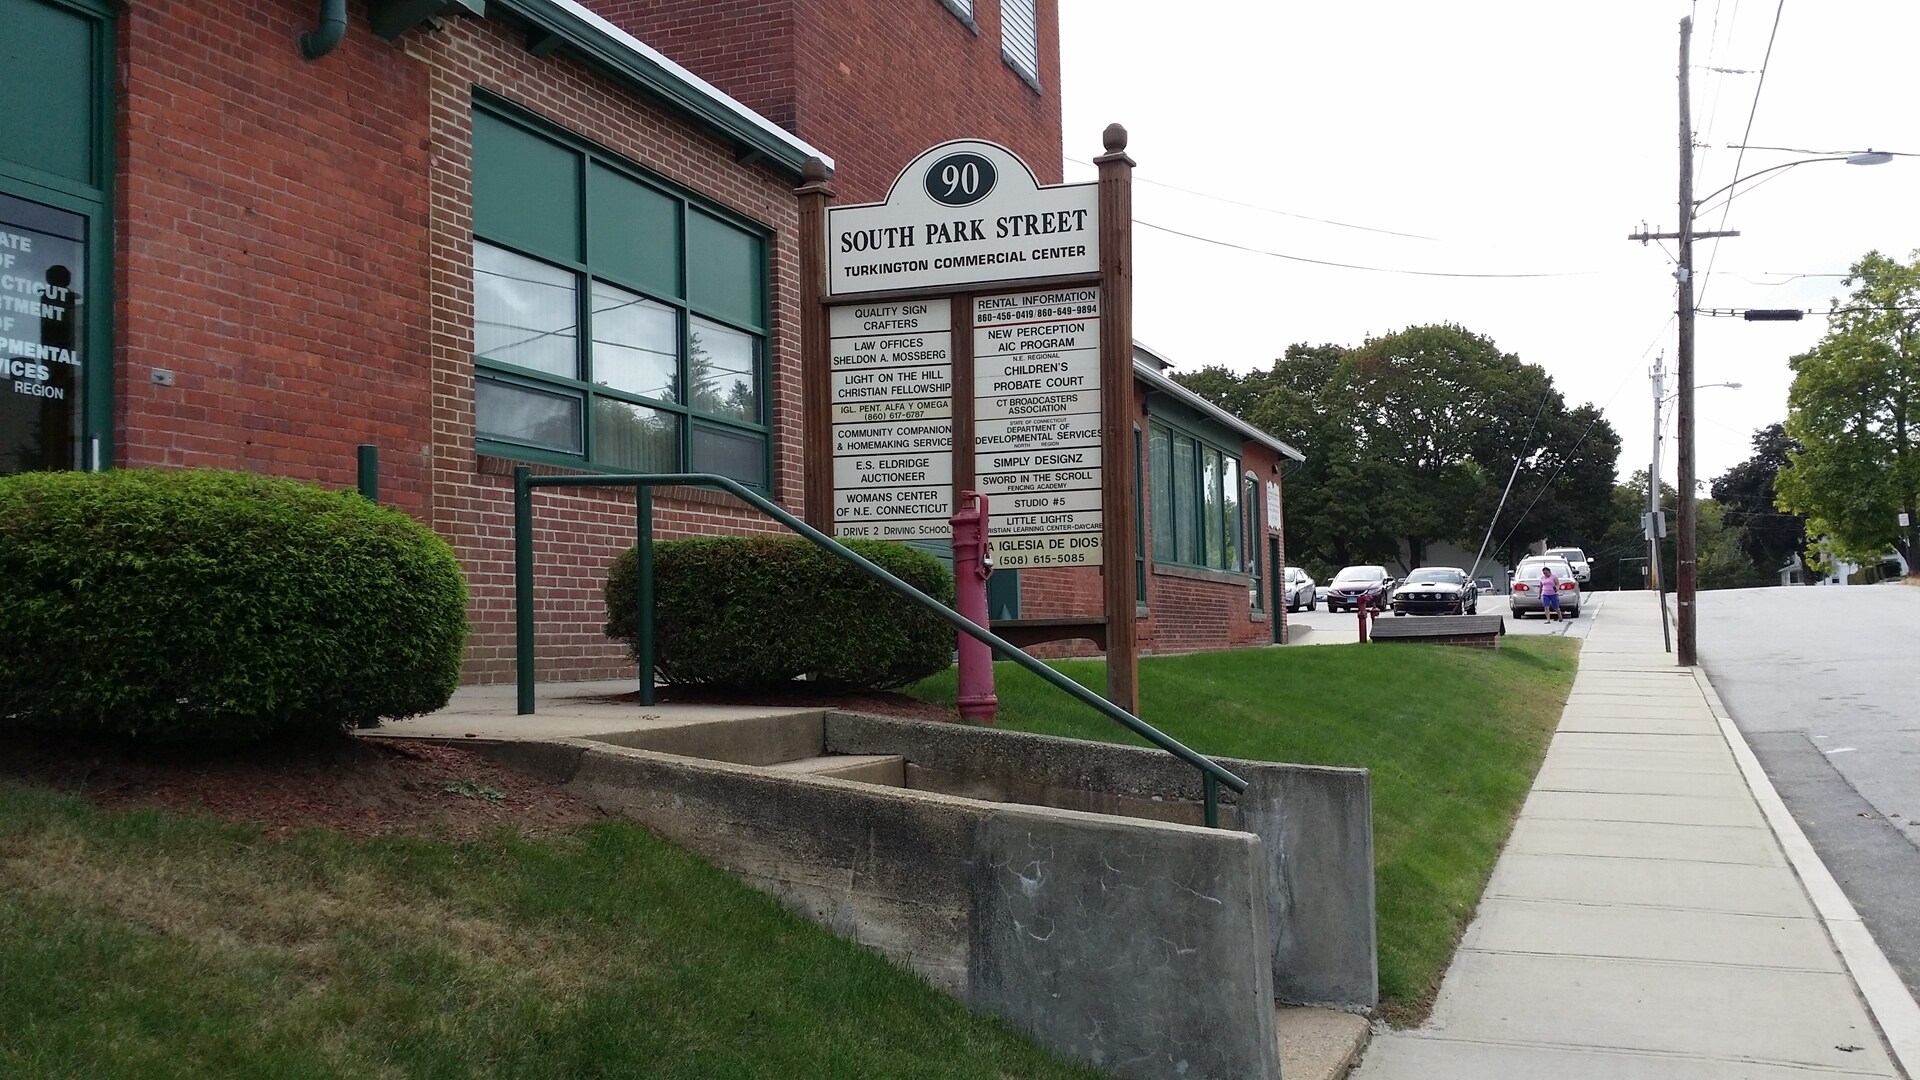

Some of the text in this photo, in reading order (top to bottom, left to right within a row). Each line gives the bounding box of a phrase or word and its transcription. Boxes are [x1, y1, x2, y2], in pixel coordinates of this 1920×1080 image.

[942, 162, 979, 197] 90
[841, 208, 1088, 253] SOUTH PARK STREET
[0, 254, 15, 268] F
[844, 246, 1086, 277] TURKINGTON COMMERCIAL CENTER
[978, 291, 1096, 309] RENTAL INFORMATION
[0, 294, 64, 321] TMENT
[855, 305, 927, 318] QUALITY SIGN
[0, 316, 15, 331] F
[864, 319, 918, 330] CRAFTERS
[988, 323, 1084, 340] NEW PERCEPTION
[854, 338, 924, 350] LAW OFFICES
[998, 338, 1074, 352] AIC PROGRAM
[834, 350, 946, 365] SHELDON A. MOSSBERG
[1028, 352, 1060, 360] REGIONAL
[1004, 362, 1068, 376] CHILDREN'S
[846, 370, 943, 384] LIGHT ON THE HILL
[994, 376, 1084, 391] PROBATE COURT
[15, 381, 64, 400] REGION
[838, 383, 951, 398] CHRISTIAN FELLOWSHIP
[885, 403, 905, 411] ALFA
[917, 400, 948, 409] OMEGA
[996, 394, 1078, 407] CT BROADCASTERS
[1008, 404, 1066, 414] ASSOCIATION
[838, 426, 952, 438] COMMUNITY COMPANION
[1006, 424, 1056, 434] DEPARTMENT
[837, 438, 952, 450] & HOMEMAKING SERVICE
[976, 432, 1052, 444] DEVELOPMENTAL
[856, 458, 930, 470] E.S. ELDRIDGE
[994, 454, 1083, 468] SIMPLY DESIGNZ
[861, 472, 926, 482] AUCTIONEER
[982, 472, 1092, 485] SWORD IN THE SCROLL
[846, 491, 938, 502] WOMANS CENTER
[1014, 498, 1066, 508] STUDIO #5
[836, 504, 948, 516] OF N.E. CONNECTICUT
[1007, 514, 1074, 526] LITTLE LIGHTS
[844, 527, 868, 536] DRIVE
[874, 526, 878, 535] 2
[1000, 540, 1044, 551] IGLESIA
[1050, 539, 1064, 548] DE
[1070, 537, 1098, 548] DIOS
[1000, 554, 1084, 565] (508) 615-5085
